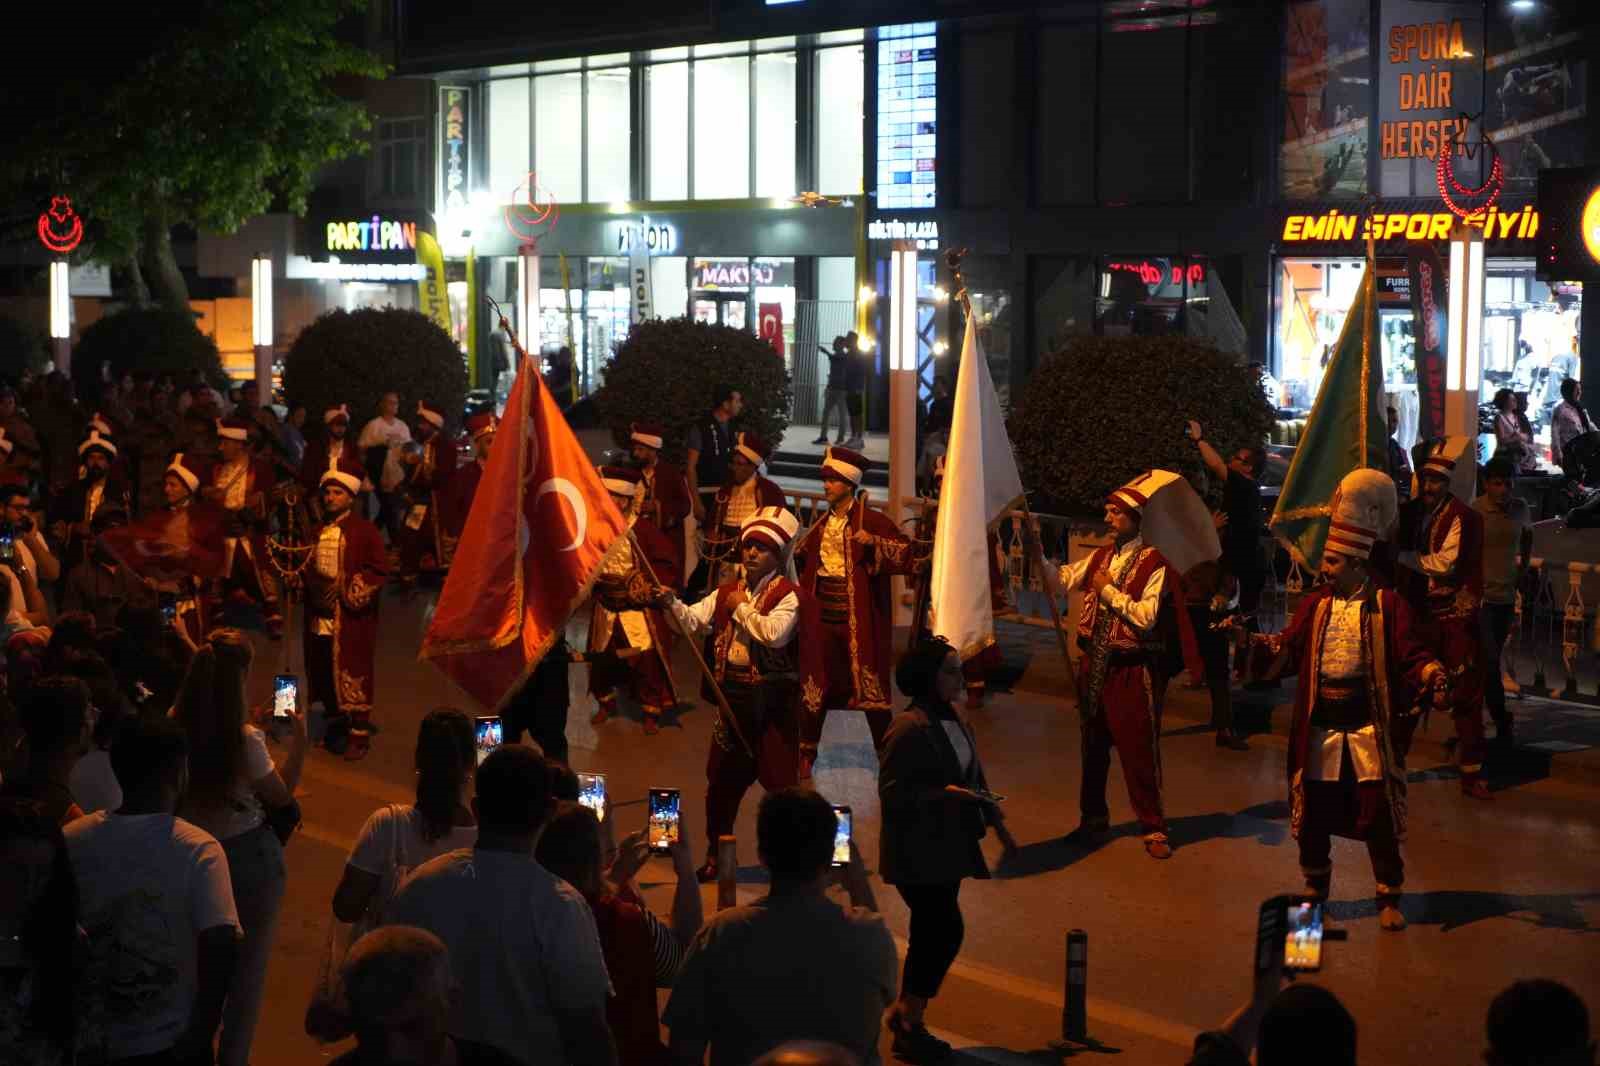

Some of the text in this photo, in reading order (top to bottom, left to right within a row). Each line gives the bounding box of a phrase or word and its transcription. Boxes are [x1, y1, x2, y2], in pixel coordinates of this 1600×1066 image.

[1389, 21, 1464, 63] SPORA
[1399, 64, 1452, 111] DAİR
[327, 215, 416, 250] PARTİPAN
[1283, 209, 1356, 240] EMİN
[1362, 214, 1453, 240] SPOR
